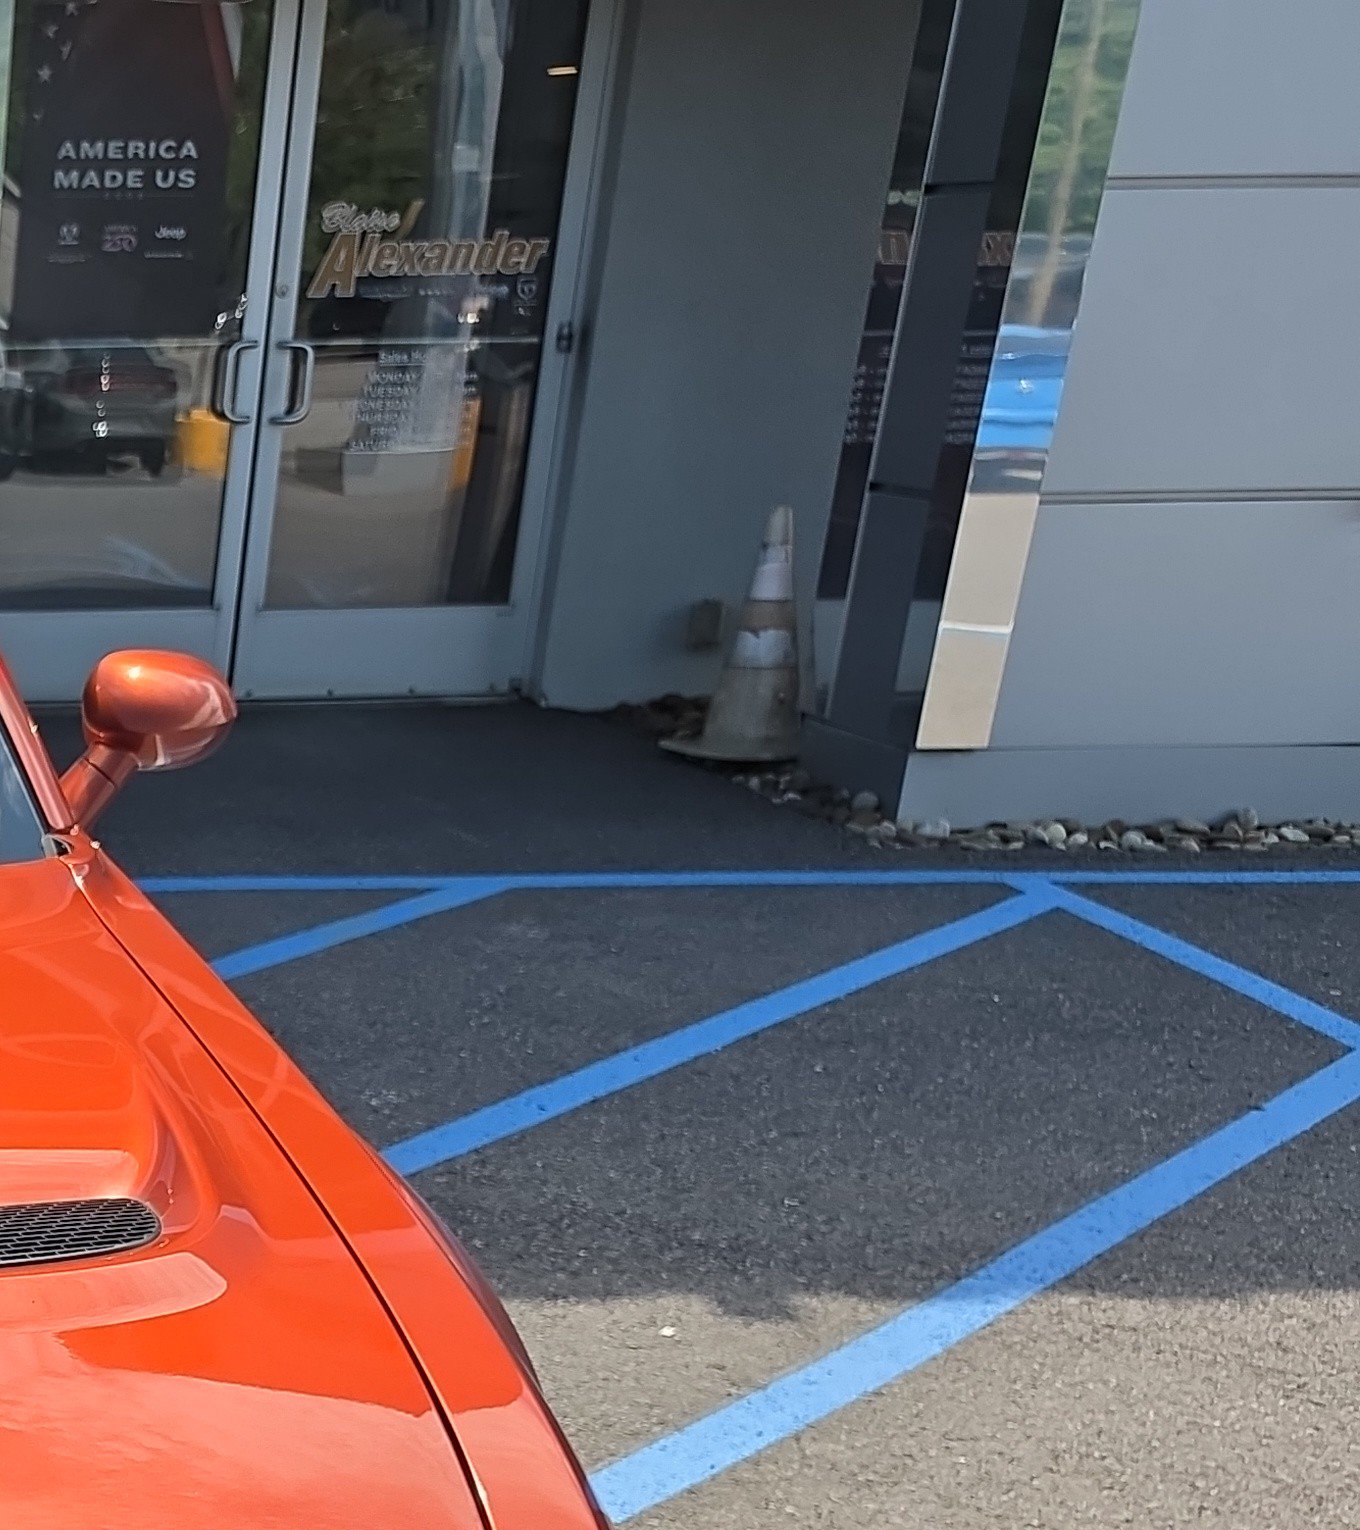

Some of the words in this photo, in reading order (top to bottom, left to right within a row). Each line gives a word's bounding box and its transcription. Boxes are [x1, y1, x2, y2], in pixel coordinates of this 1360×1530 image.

[56, 139, 198, 160] AMERICA
[53, 168, 144, 189] MADE
[154, 168, 196, 189] US
[306, 228, 551, 298] Alexander
